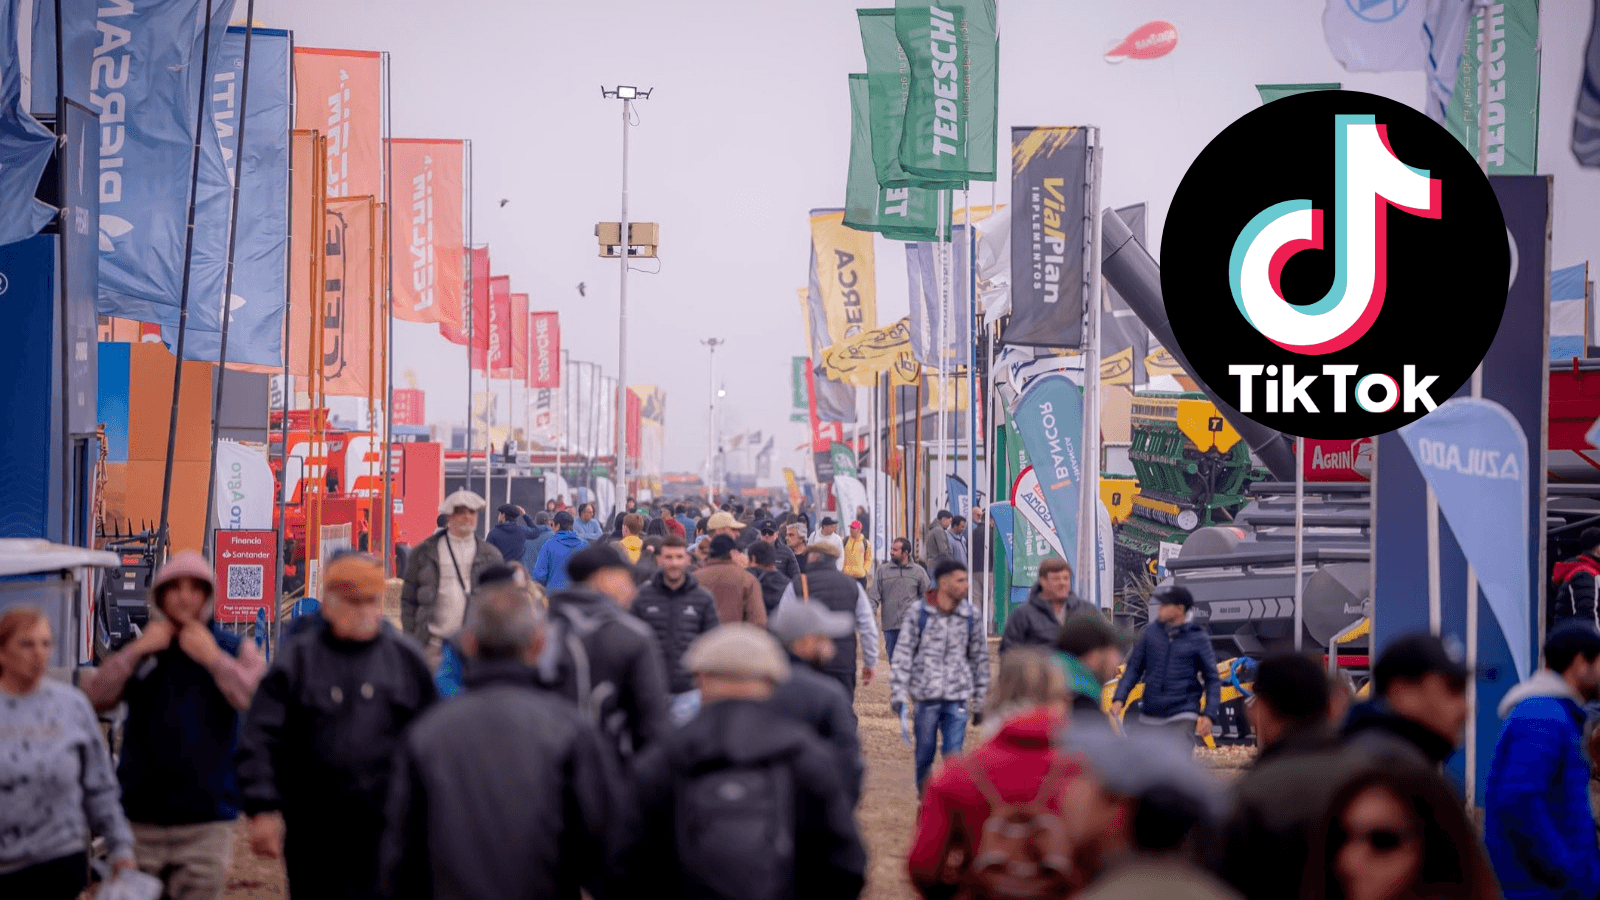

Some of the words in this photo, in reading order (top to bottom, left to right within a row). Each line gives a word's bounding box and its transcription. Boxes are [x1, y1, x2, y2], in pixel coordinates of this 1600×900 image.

[930, 5, 959, 157] TEDESCHI
[1031, 186, 1042, 290] IMPLEMENTOS
[232, 551, 270, 559] Santander
